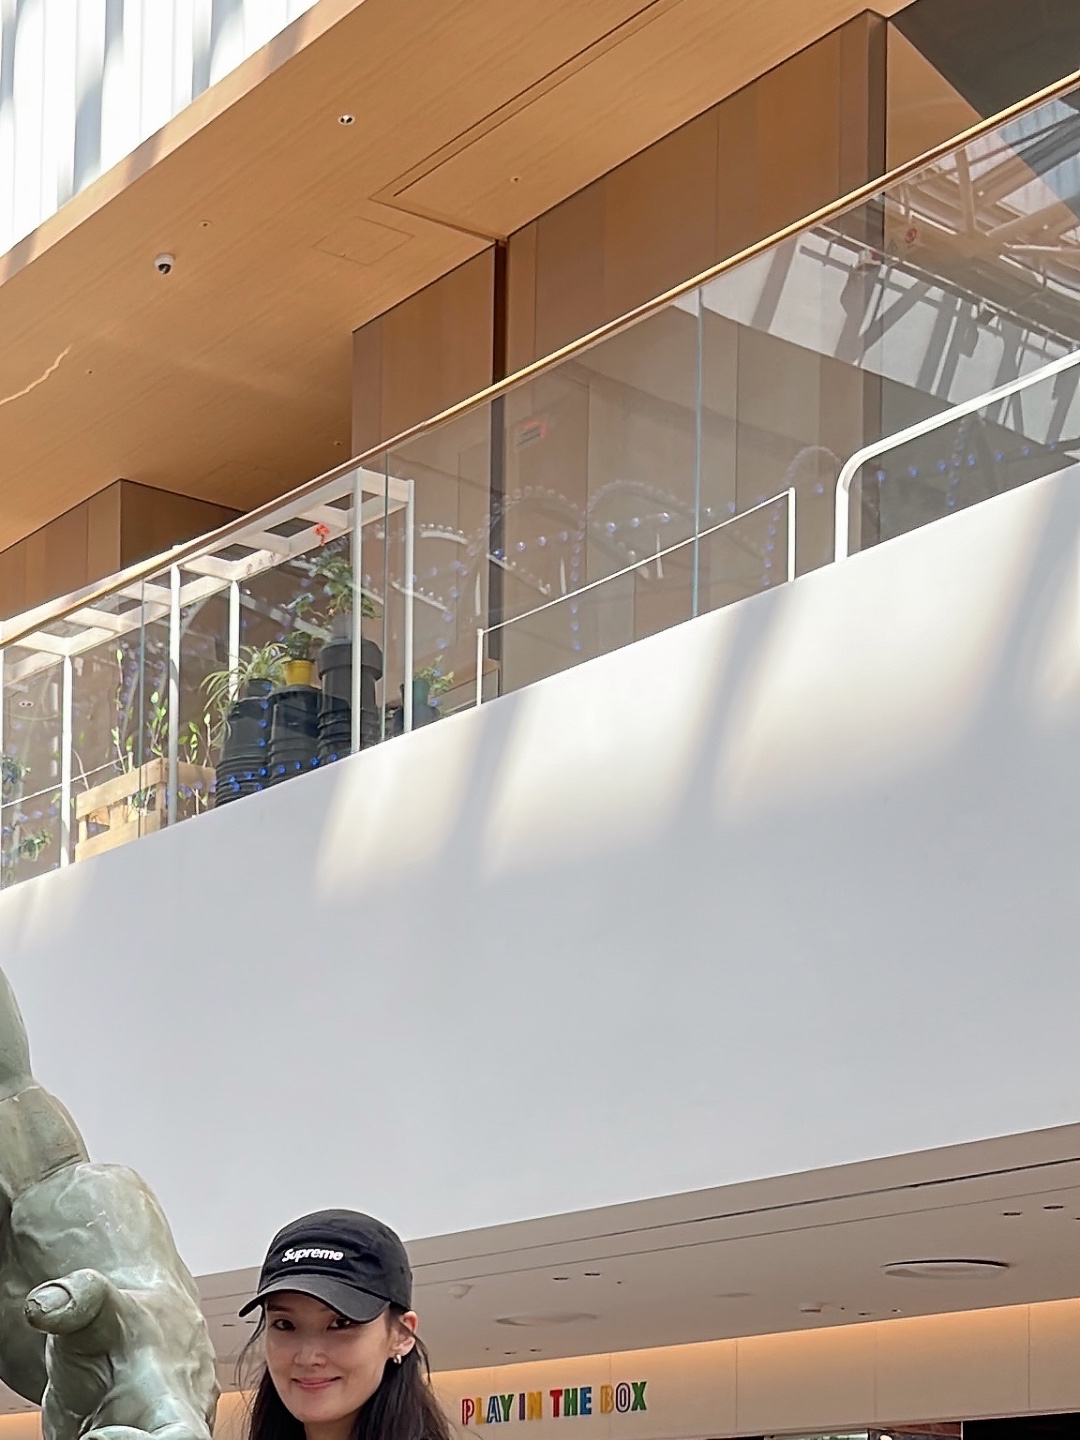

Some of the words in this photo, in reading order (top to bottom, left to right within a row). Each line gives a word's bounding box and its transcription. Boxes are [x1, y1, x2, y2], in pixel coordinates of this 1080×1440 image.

[282, 1248, 344, 1263] Supreme
[461, 1393, 514, 1426] PLAY
[518, 1391, 543, 1421] IN
[549, 1386, 592, 1418] THE
[600, 1381, 647, 1415] BOX
